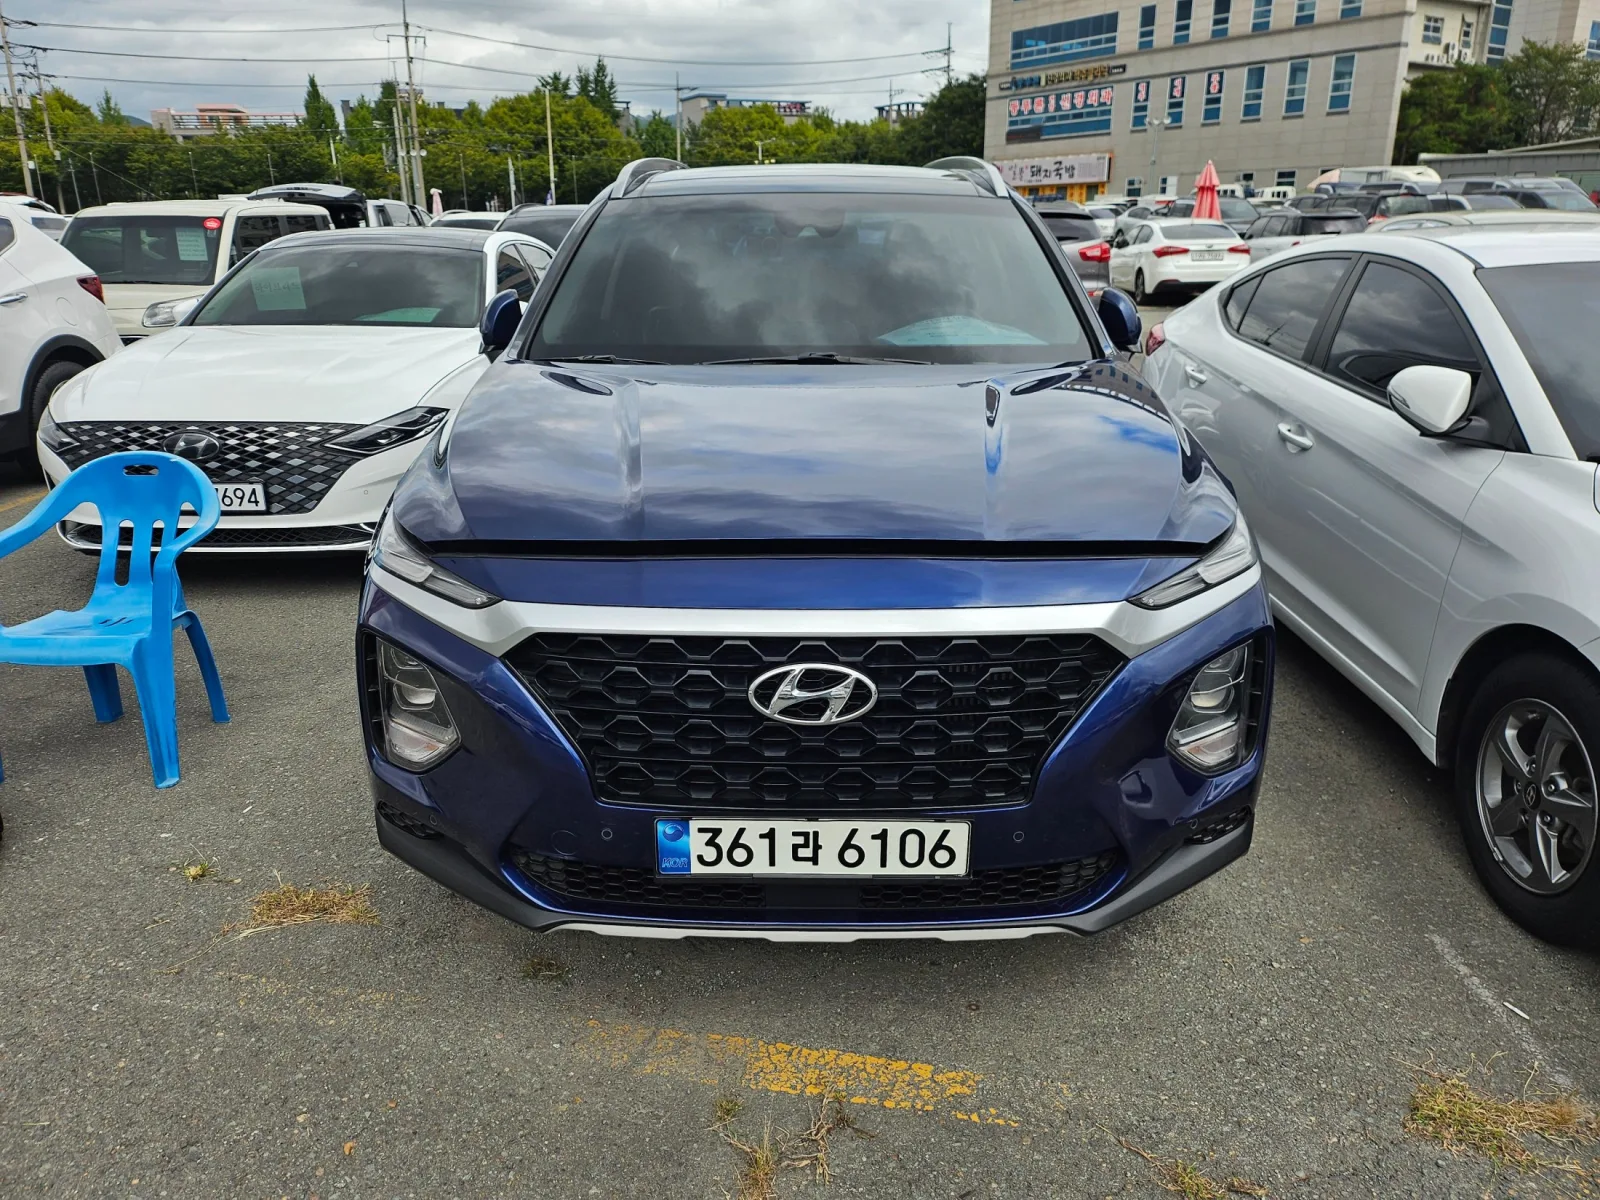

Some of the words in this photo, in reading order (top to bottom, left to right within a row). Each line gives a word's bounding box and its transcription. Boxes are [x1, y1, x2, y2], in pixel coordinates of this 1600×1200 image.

[1030, 160, 1075, 180] 돼지국밥
[215, 487, 259, 507] 694
[696, 827, 822, 868] 361라
[837, 828, 956, 868] 6106
